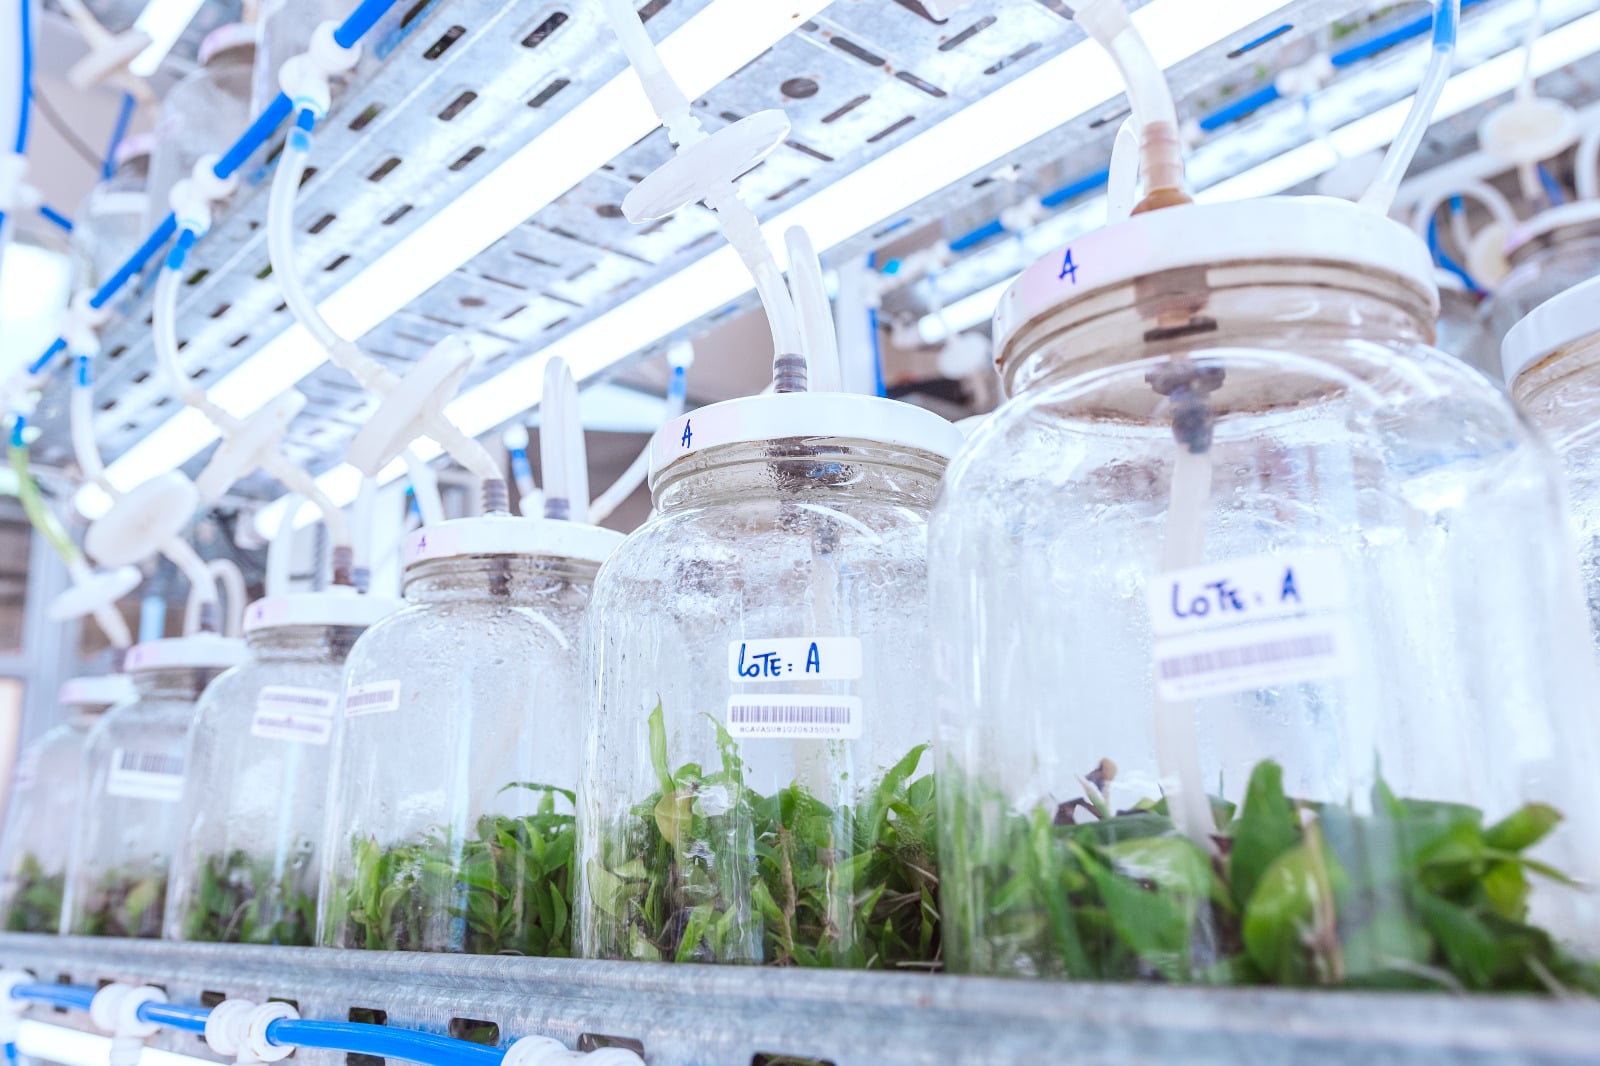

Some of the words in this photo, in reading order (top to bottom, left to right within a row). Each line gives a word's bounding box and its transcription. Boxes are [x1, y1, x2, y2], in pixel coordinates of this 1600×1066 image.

[1058, 247, 1079, 285] A
[681, 418, 693, 449] A
[1280, 566, 1302, 602] A
[805, 641, 820, 673] A
